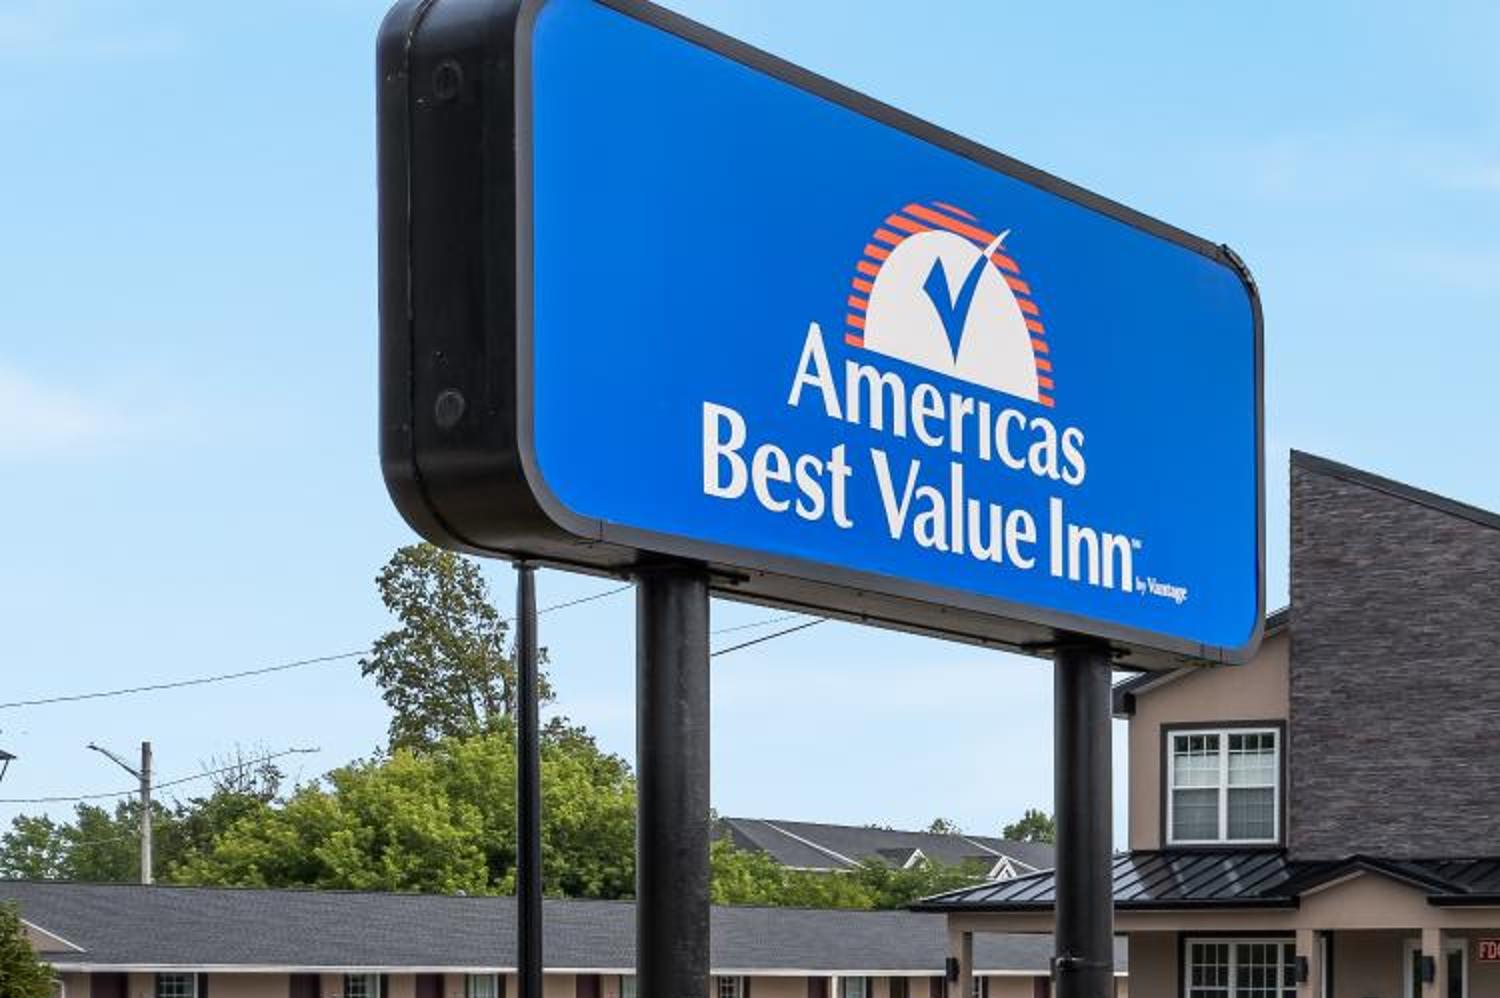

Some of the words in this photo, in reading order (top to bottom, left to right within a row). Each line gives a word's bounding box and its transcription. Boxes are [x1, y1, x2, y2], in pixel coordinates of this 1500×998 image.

[787, 322, 1086, 486] Americas
[703, 401, 853, 529] Best
[870, 448, 1037, 569] Value
[1049, 497, 1133, 593] Inn
[1147, 577, 1188, 604] Vantage
